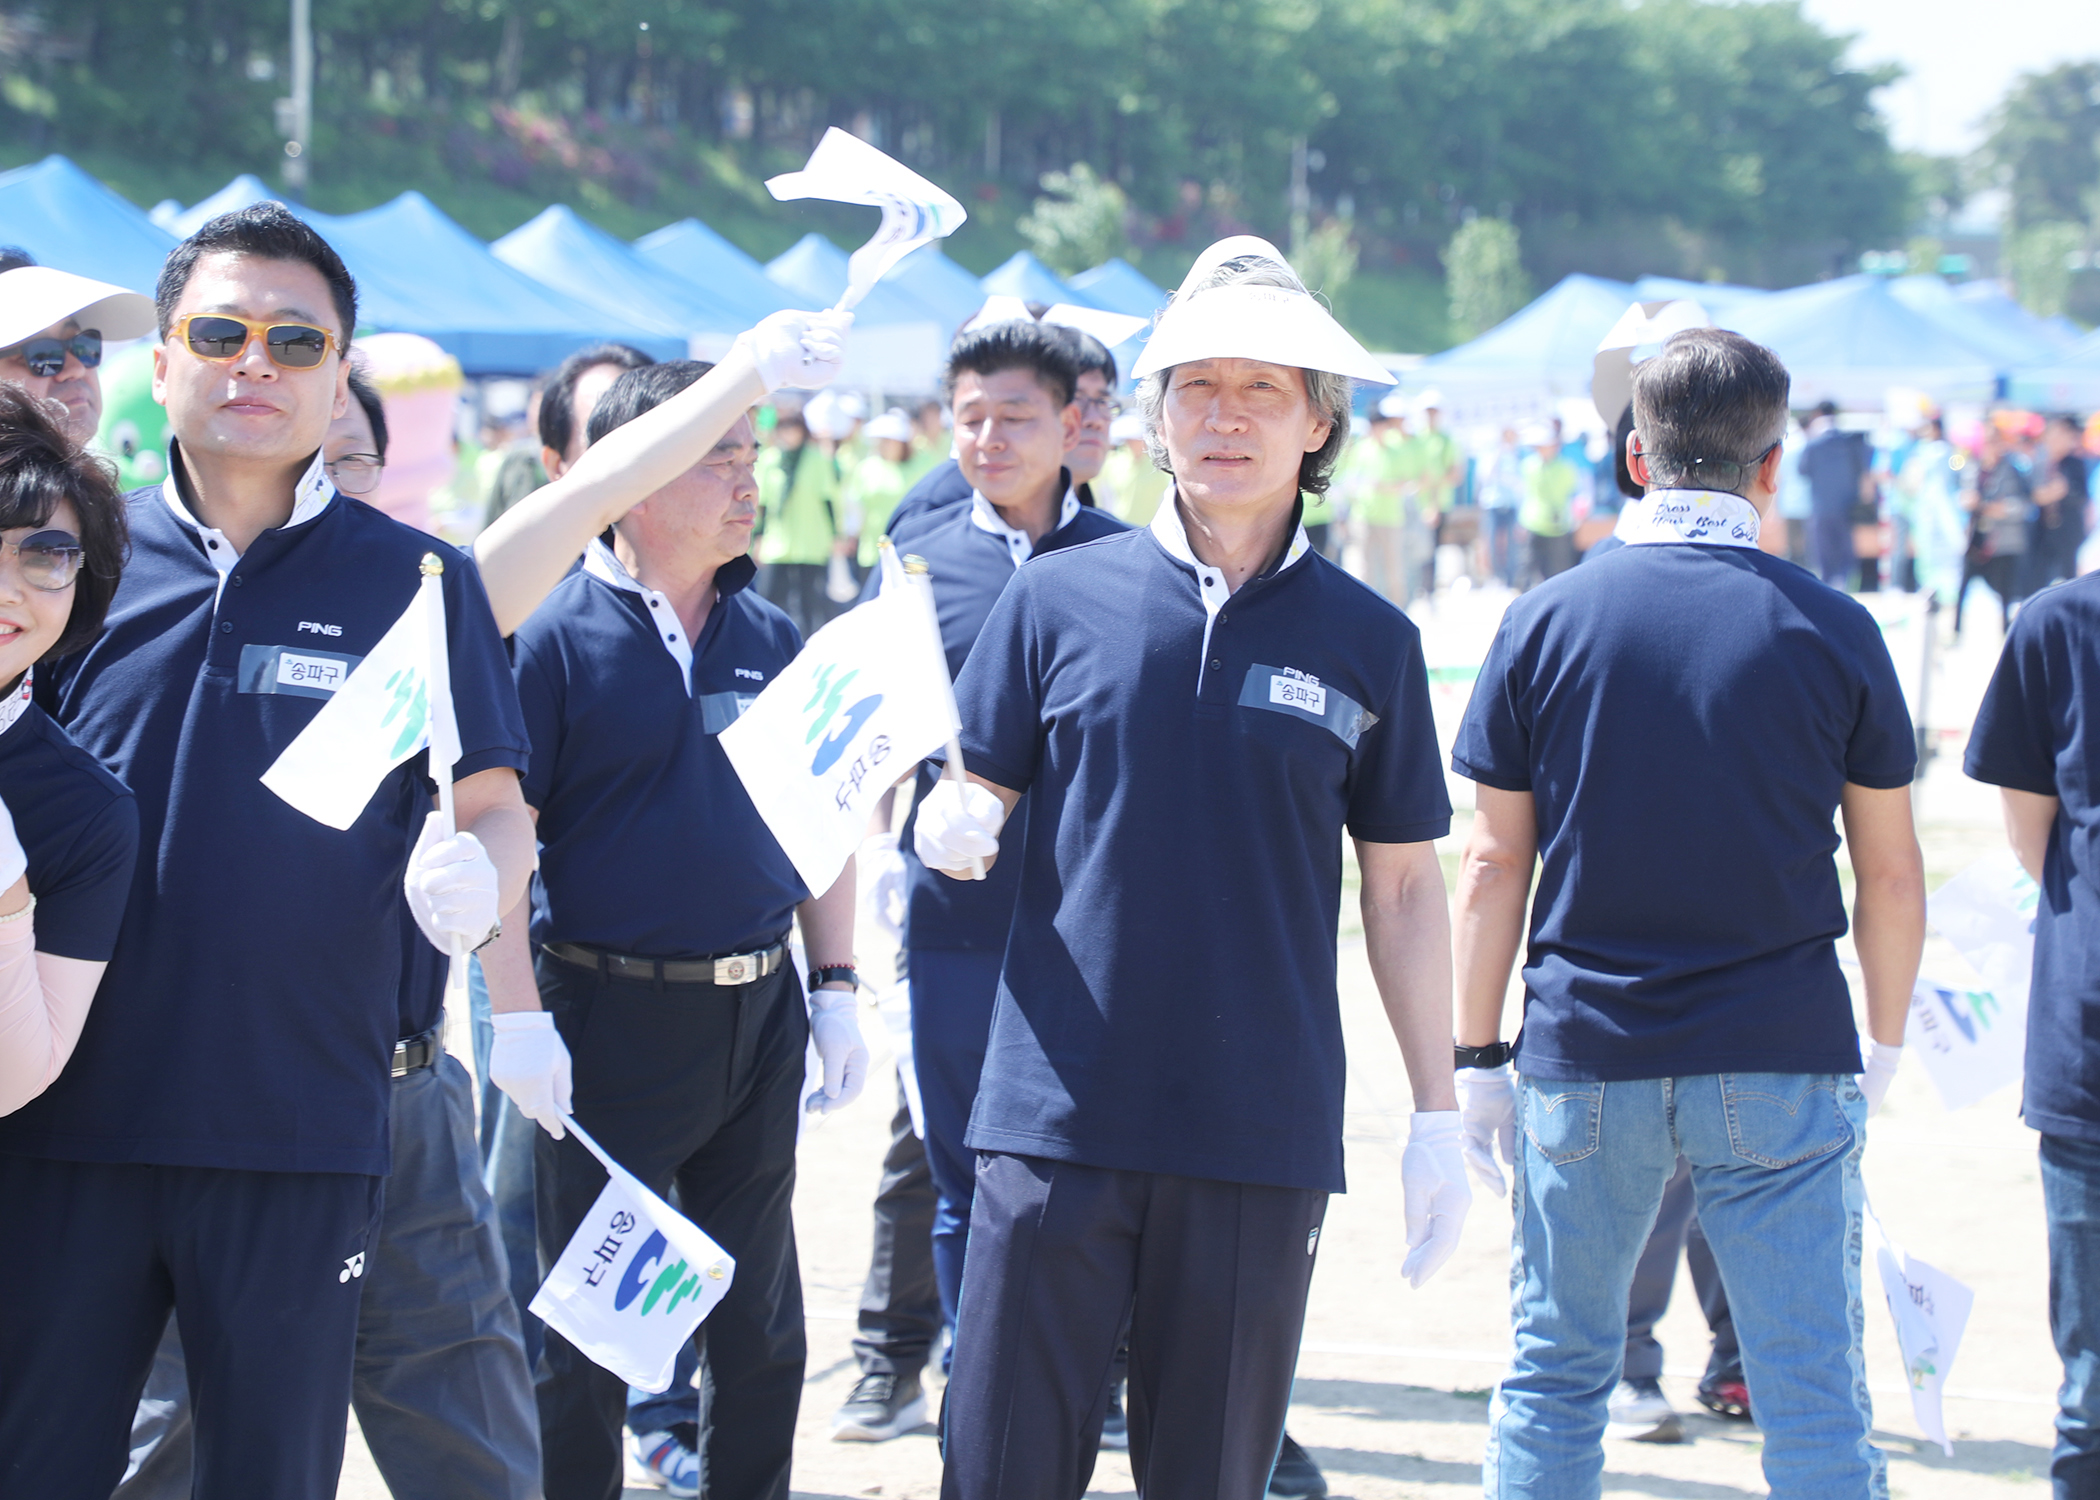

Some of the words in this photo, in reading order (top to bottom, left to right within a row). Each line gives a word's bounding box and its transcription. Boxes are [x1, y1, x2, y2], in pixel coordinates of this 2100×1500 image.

[297, 621, 343, 637] PING
[291, 662, 339, 684] 송파구
[735, 668, 764, 681] PING
[1283, 667, 1320, 687] PING
[1281, 684, 1320, 708] 송파구
[582, 1210, 636, 1287] 송파구
